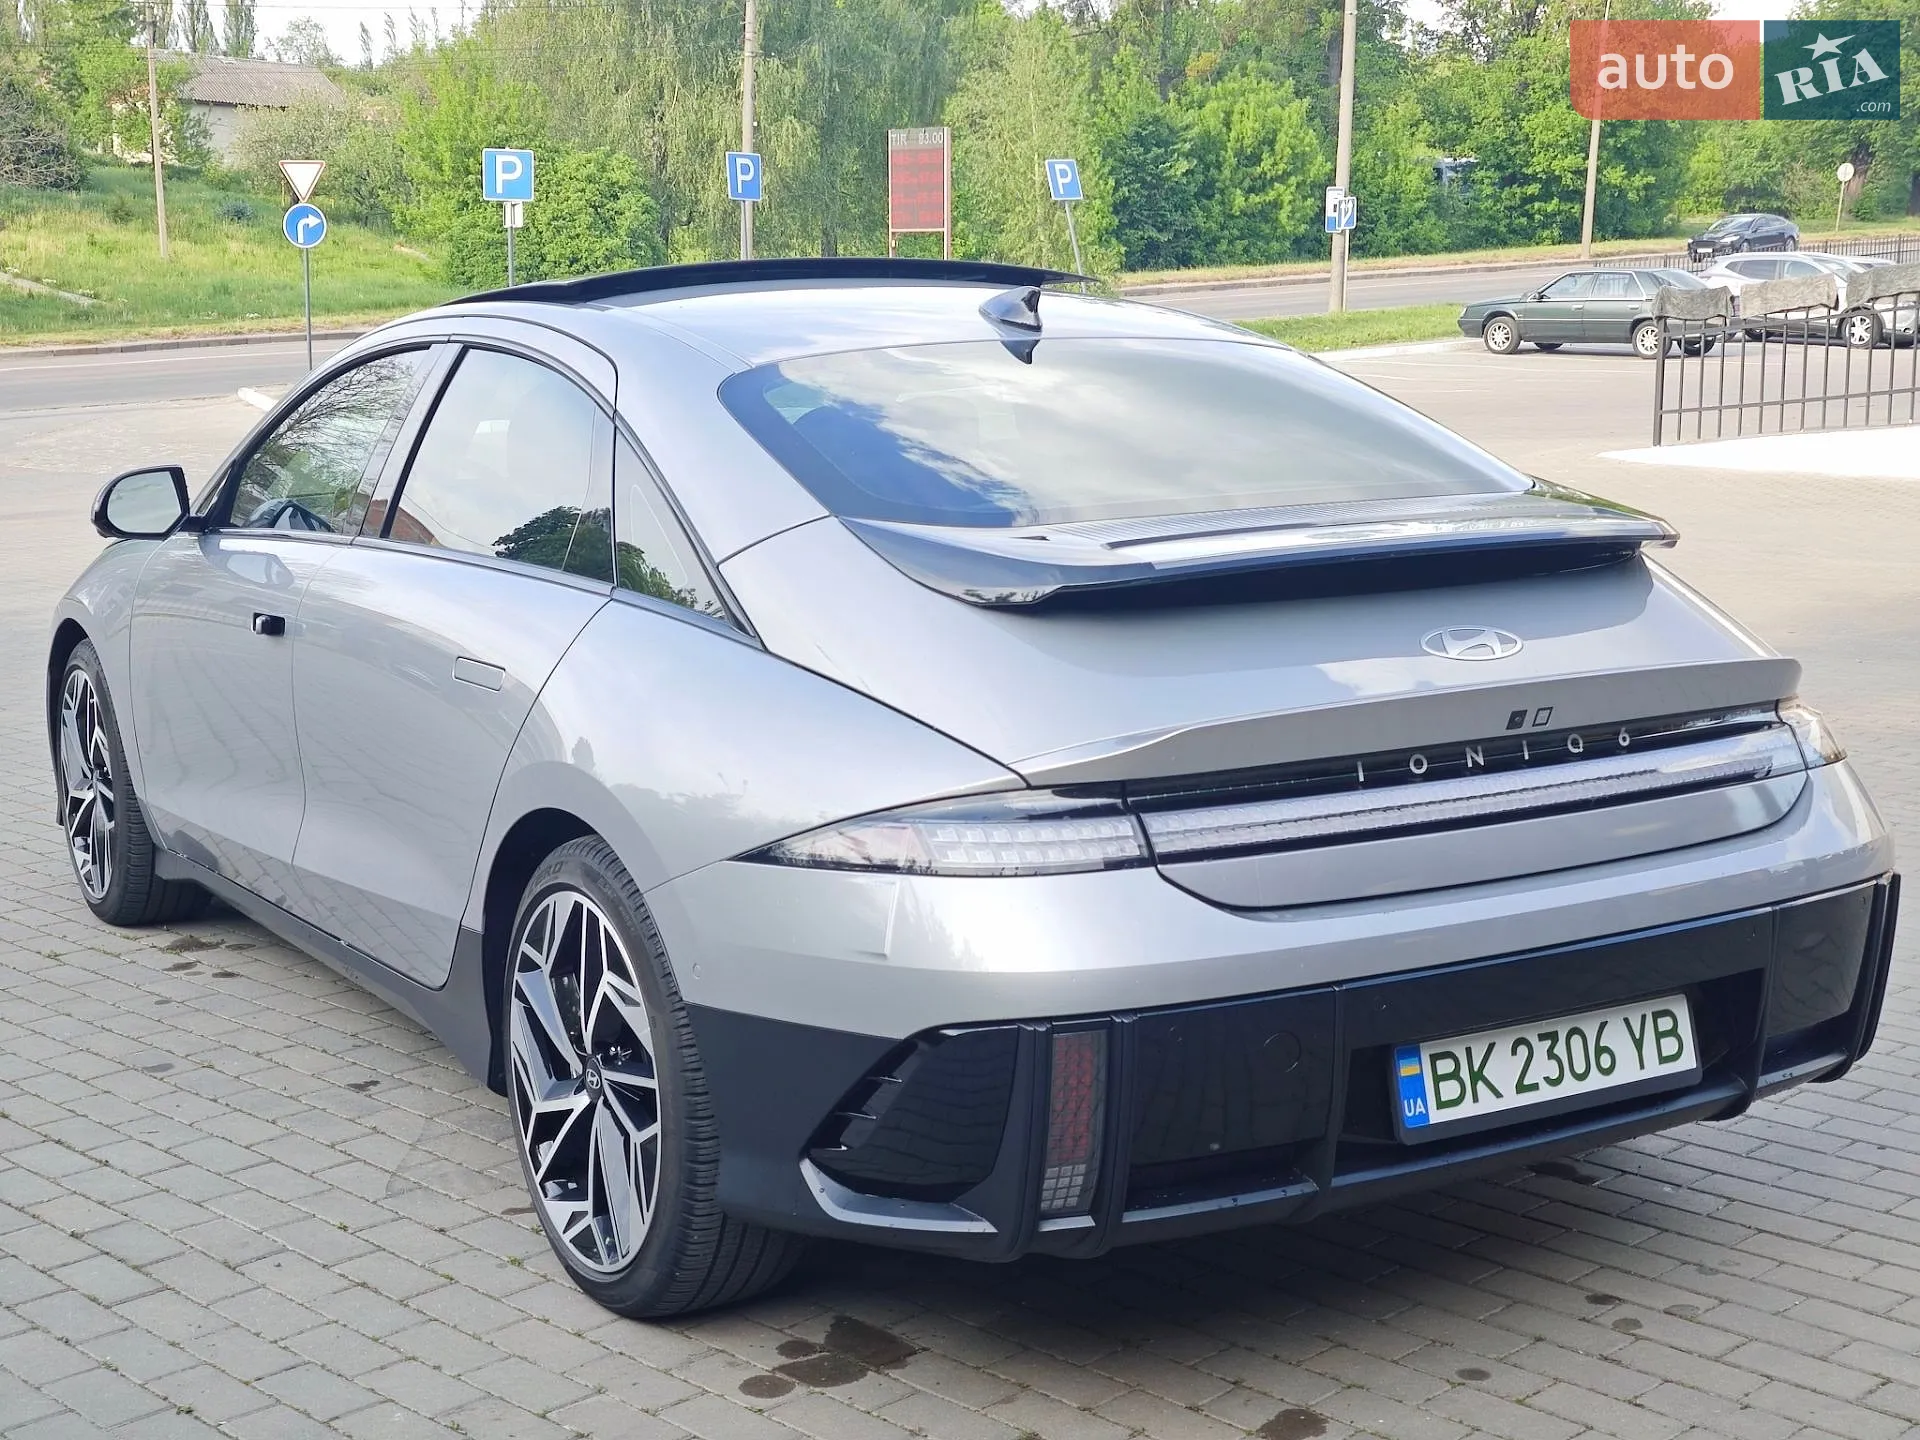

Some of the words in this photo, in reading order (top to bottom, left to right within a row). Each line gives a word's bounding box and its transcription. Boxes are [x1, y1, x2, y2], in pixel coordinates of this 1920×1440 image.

[495, 154, 523, 194] P
[736, 157, 755, 194] P
[1055, 163, 1073, 194] P
[1429, 1041, 1504, 1111] BK
[1511, 1020, 1617, 1095] 2306
[1623, 1008, 1684, 1071] YB
[1404, 1096, 1426, 1118] UA
